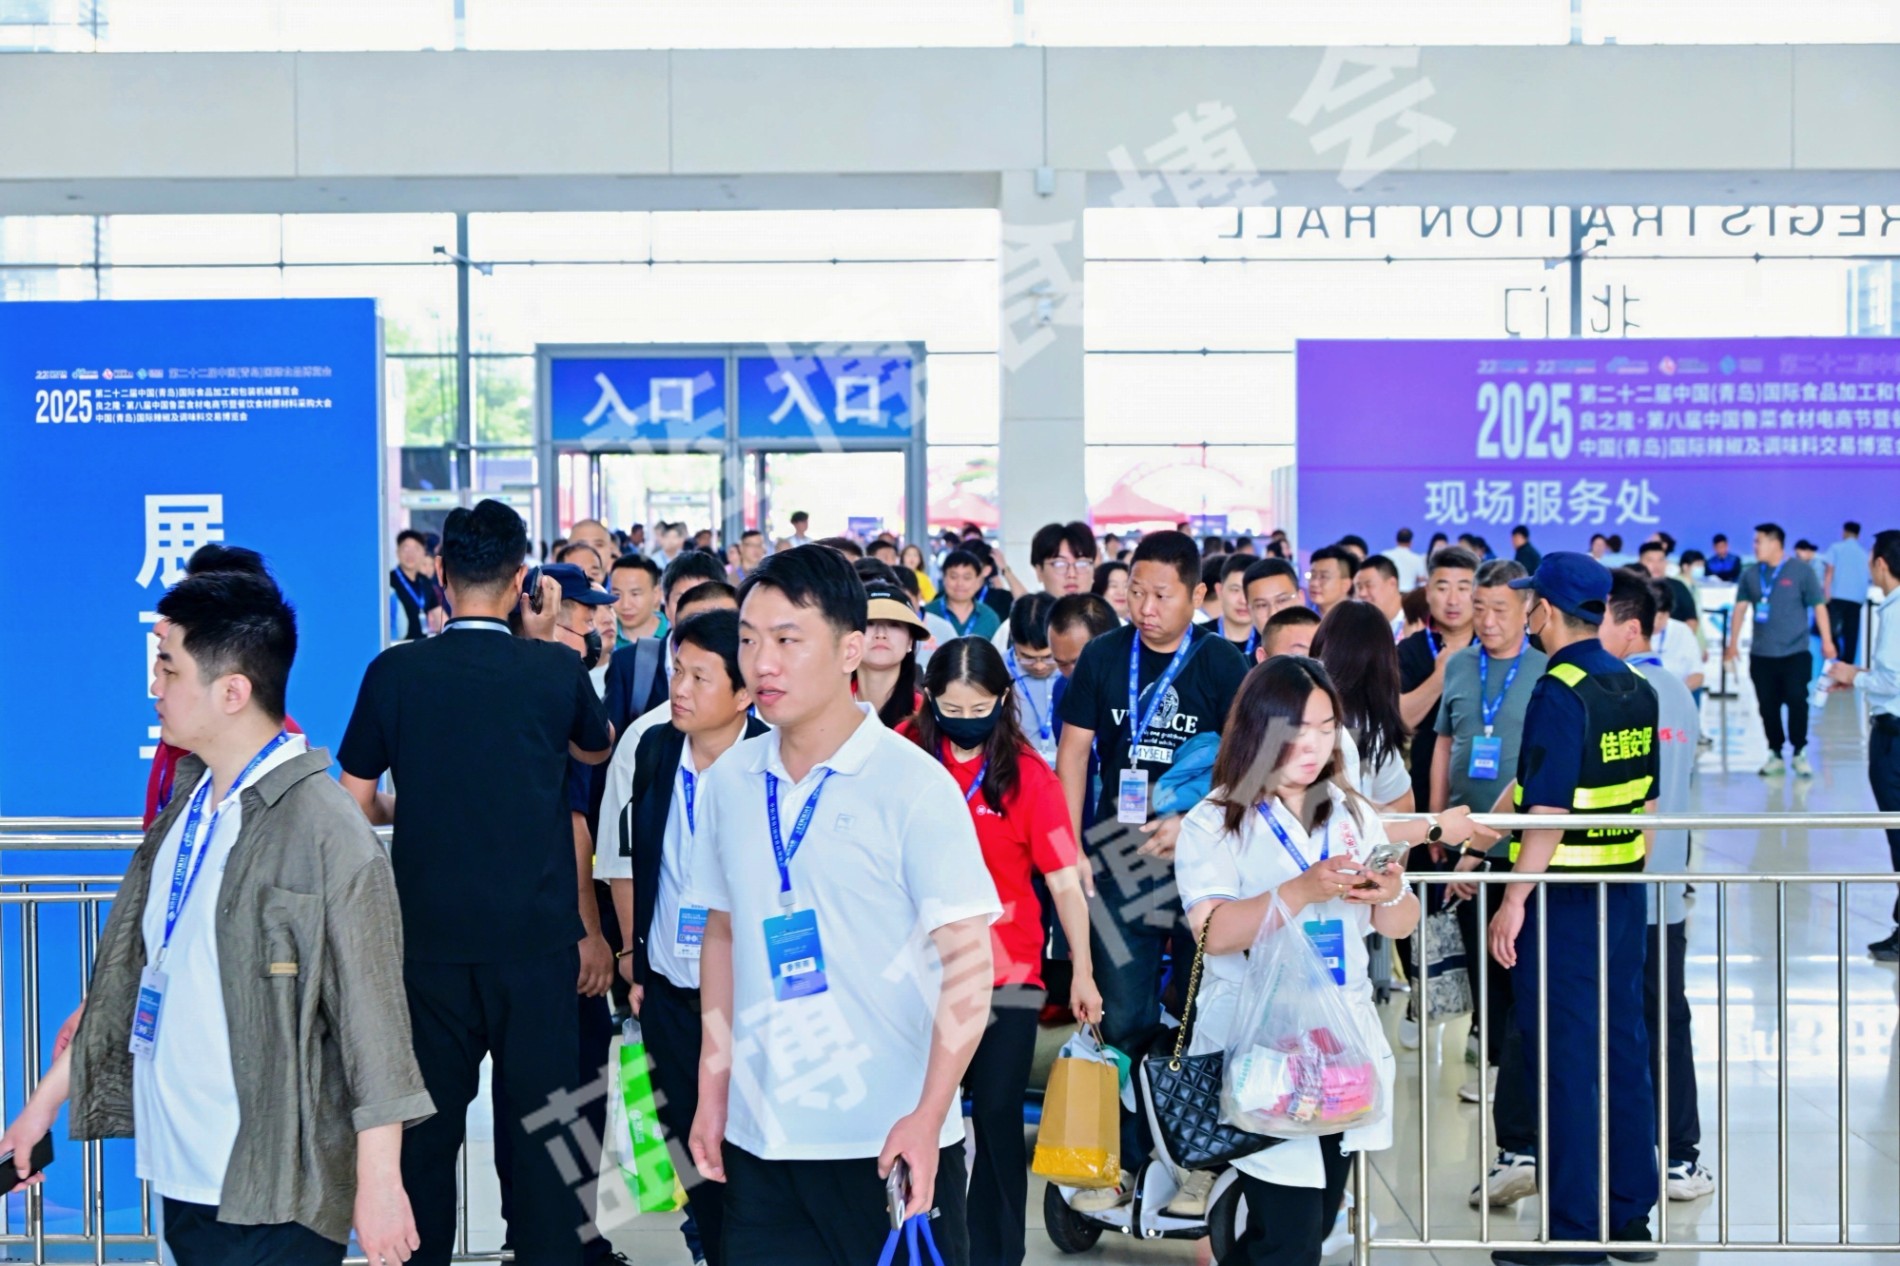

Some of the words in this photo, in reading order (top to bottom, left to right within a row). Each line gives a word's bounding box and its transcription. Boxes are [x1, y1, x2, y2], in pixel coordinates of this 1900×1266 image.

[35, 389, 93, 424] 2025
[582, 372, 695, 426] 入口
[768, 370, 880, 425] 入口
[1476, 381, 1574, 459] 2025
[1424, 478, 1661, 526] 现场服务处
